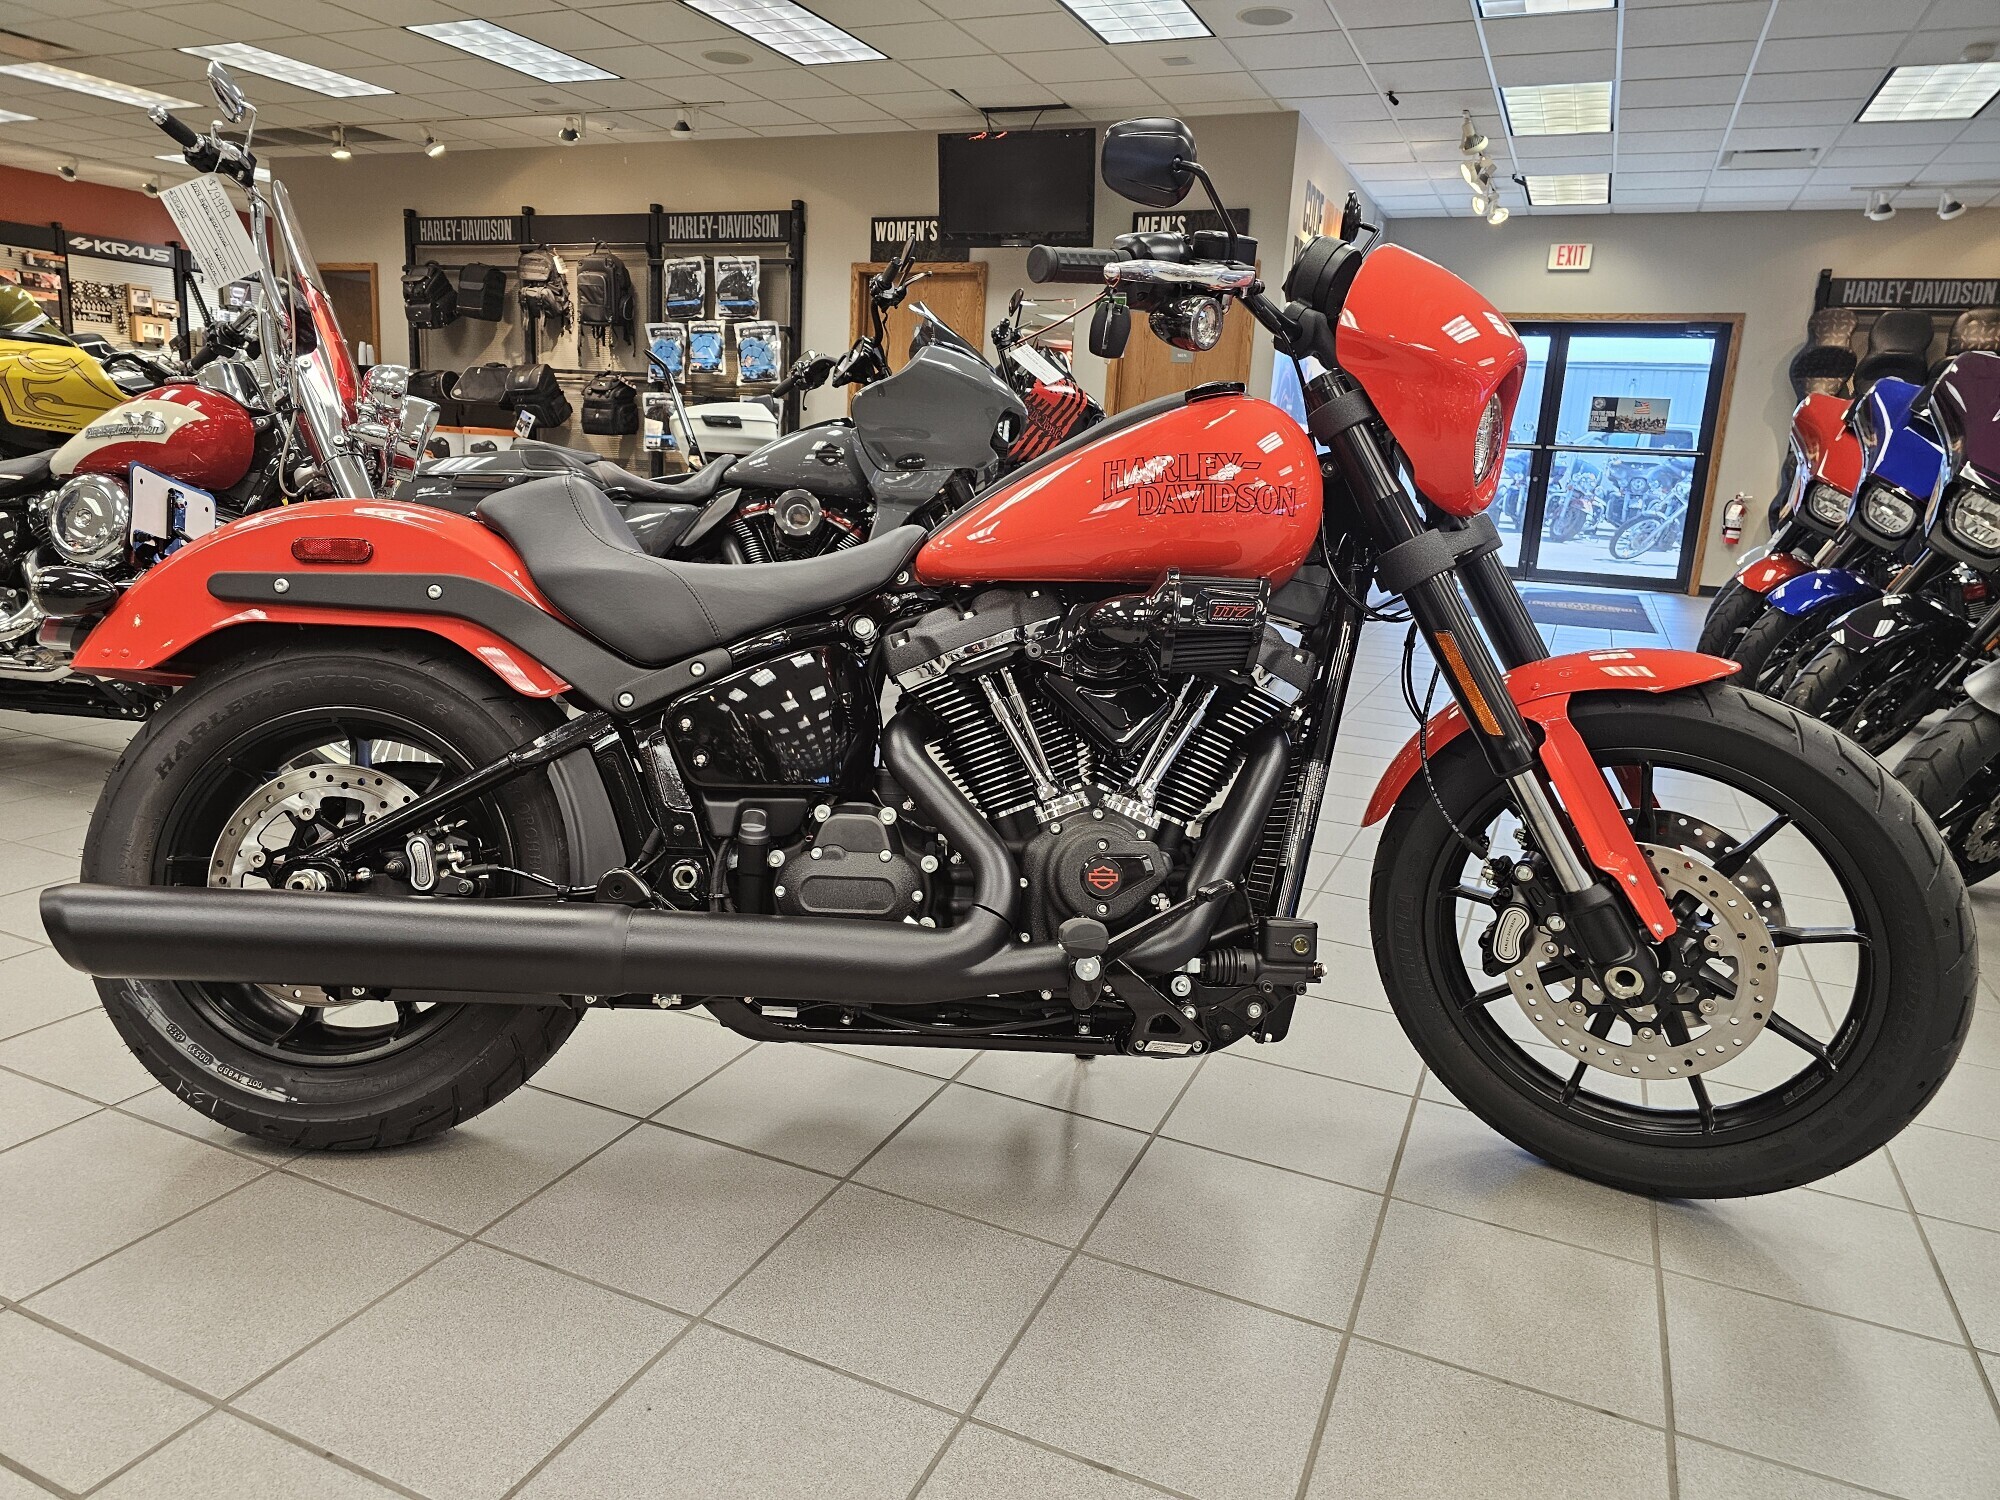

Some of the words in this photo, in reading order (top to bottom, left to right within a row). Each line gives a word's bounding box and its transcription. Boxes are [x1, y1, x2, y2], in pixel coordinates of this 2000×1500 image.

[419, 218, 513, 242] HARLEY-DAVIDSON
[669, 213, 779, 240] HARLEY-DAVIDSON
[874, 220, 938, 242] WOMEN'S
[1137, 215, 1187, 234] MEN'S
[93, 239, 171, 263] KRAUS
[1556, 245, 1587, 266] EXIT
[1842, 280, 1998, 305] HARLEY-DAVIDSON
[1103, 452, 1262, 501] HARLEY-
[1137, 483, 1297, 517] DAVIDSON
[1213, 605, 1255, 618] 117
